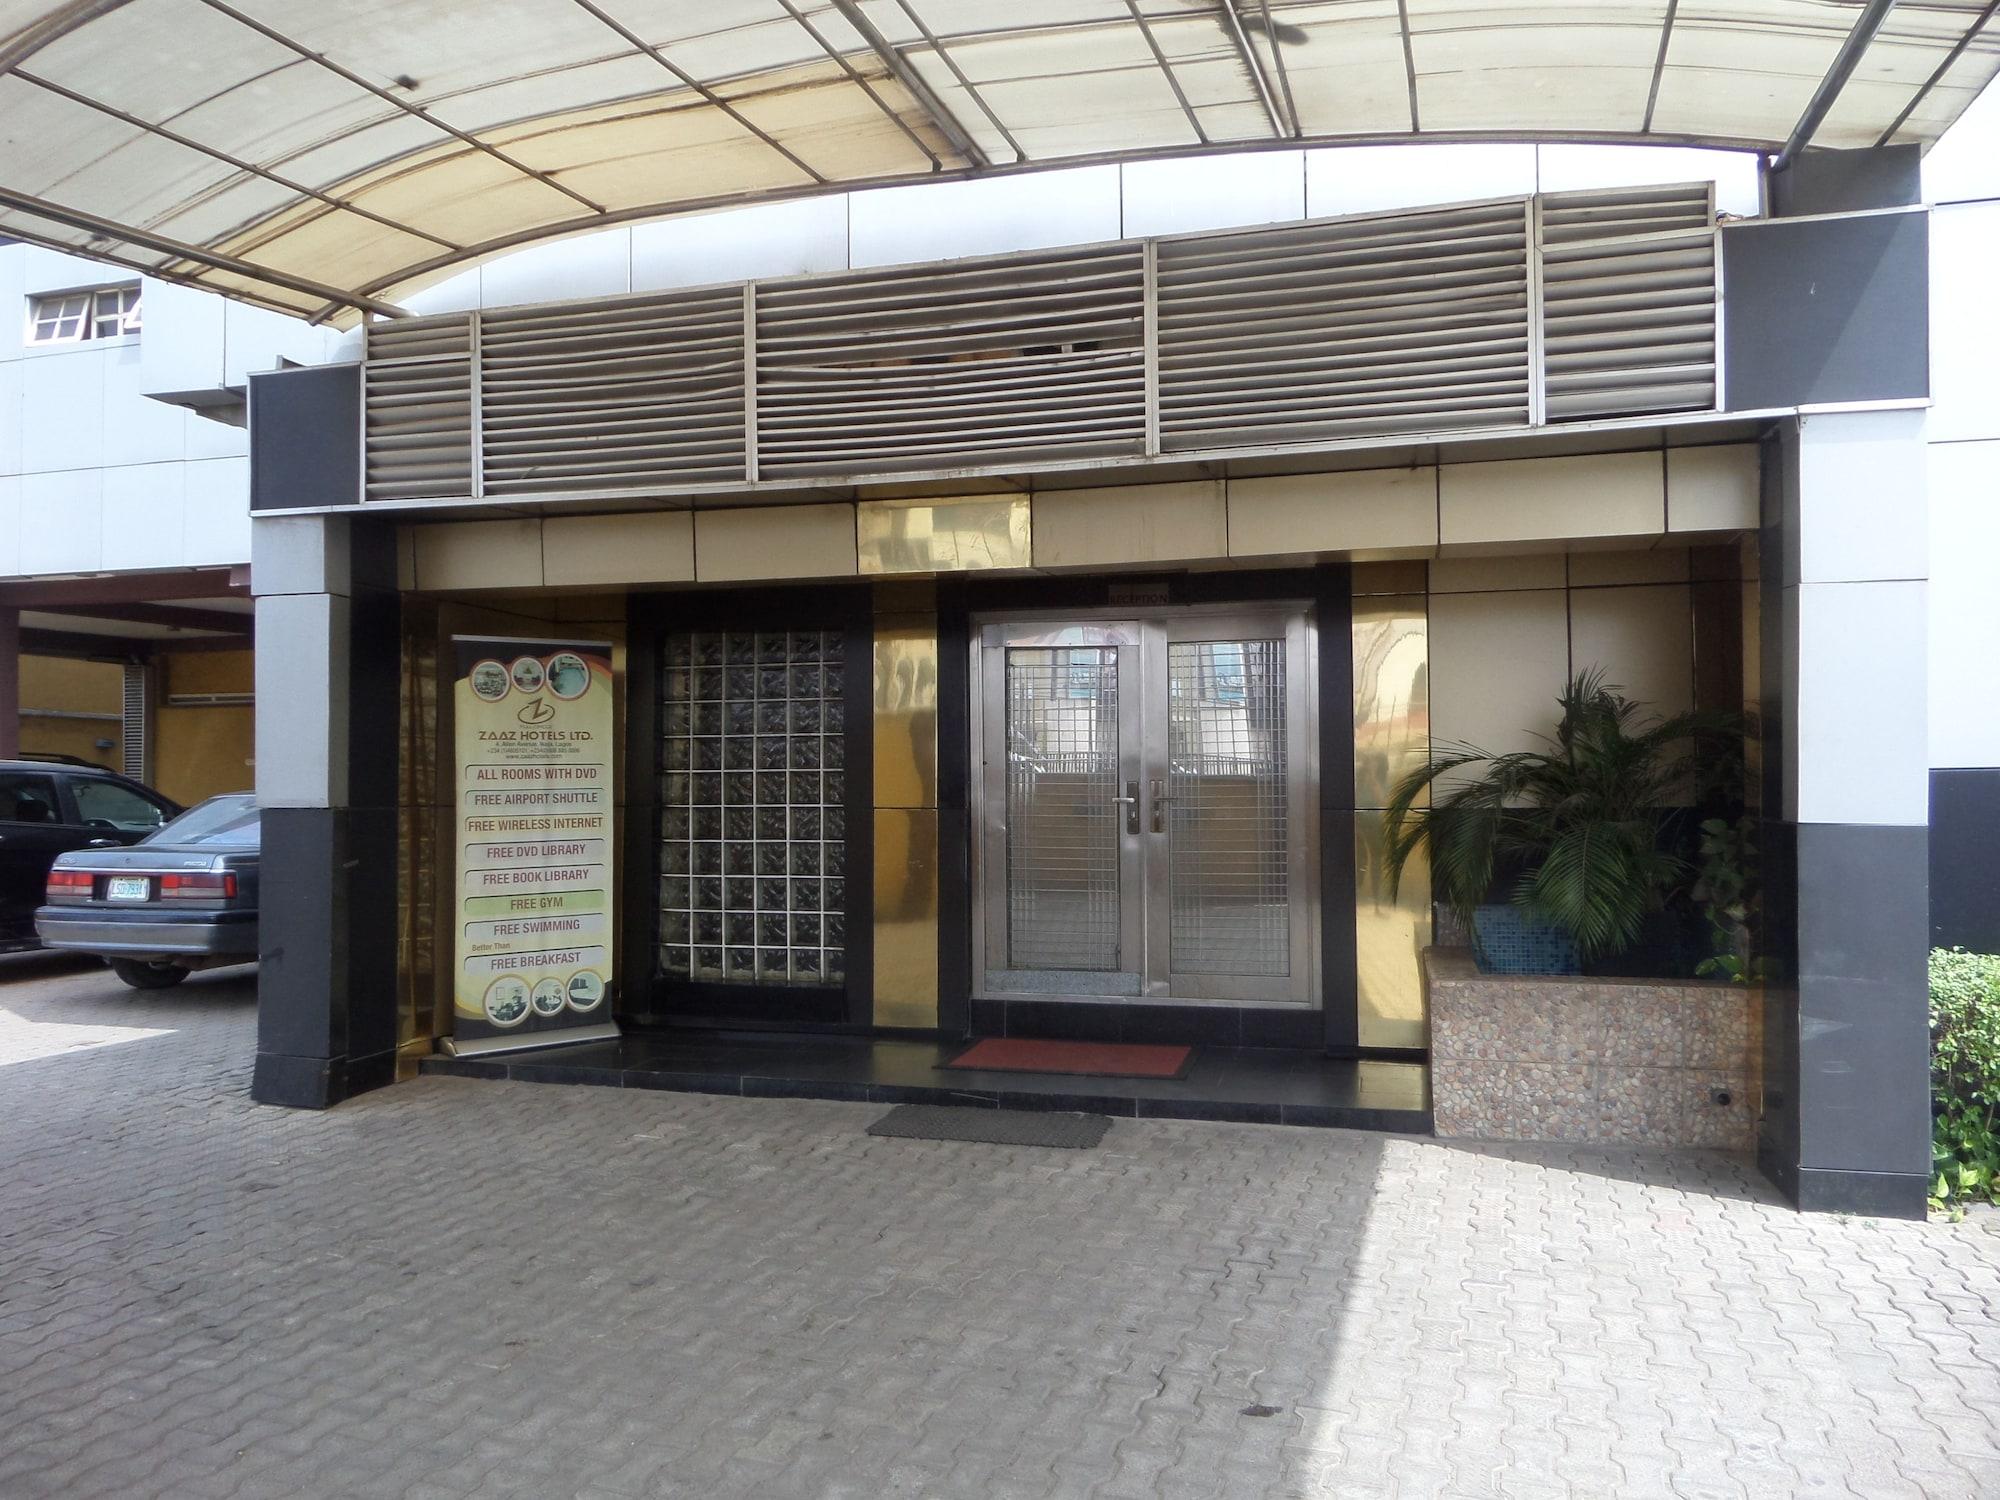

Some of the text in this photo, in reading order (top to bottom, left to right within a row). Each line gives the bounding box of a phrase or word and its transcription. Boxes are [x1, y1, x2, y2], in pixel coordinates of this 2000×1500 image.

[478, 731, 594, 741] ZAAZ HOTELS LTD.
[477, 768, 597, 781] ALL ROOMS WITH DVD
[474, 792, 598, 806] FREE AIRPORT SHUTTLE
[468, 817, 603, 832] FREE WIRELESS INTERNET
[487, 844, 586, 859] FREE DVD LIBRARY
[483, 869, 589, 885] FREE BOOK LIBRARY
[511, 896, 564, 911] FREE GYM
[494, 919, 581, 936] FREE SWIMMING
[472, 942, 511, 952] Better Than
[491, 952, 582, 971] FREE BREAKFAST
